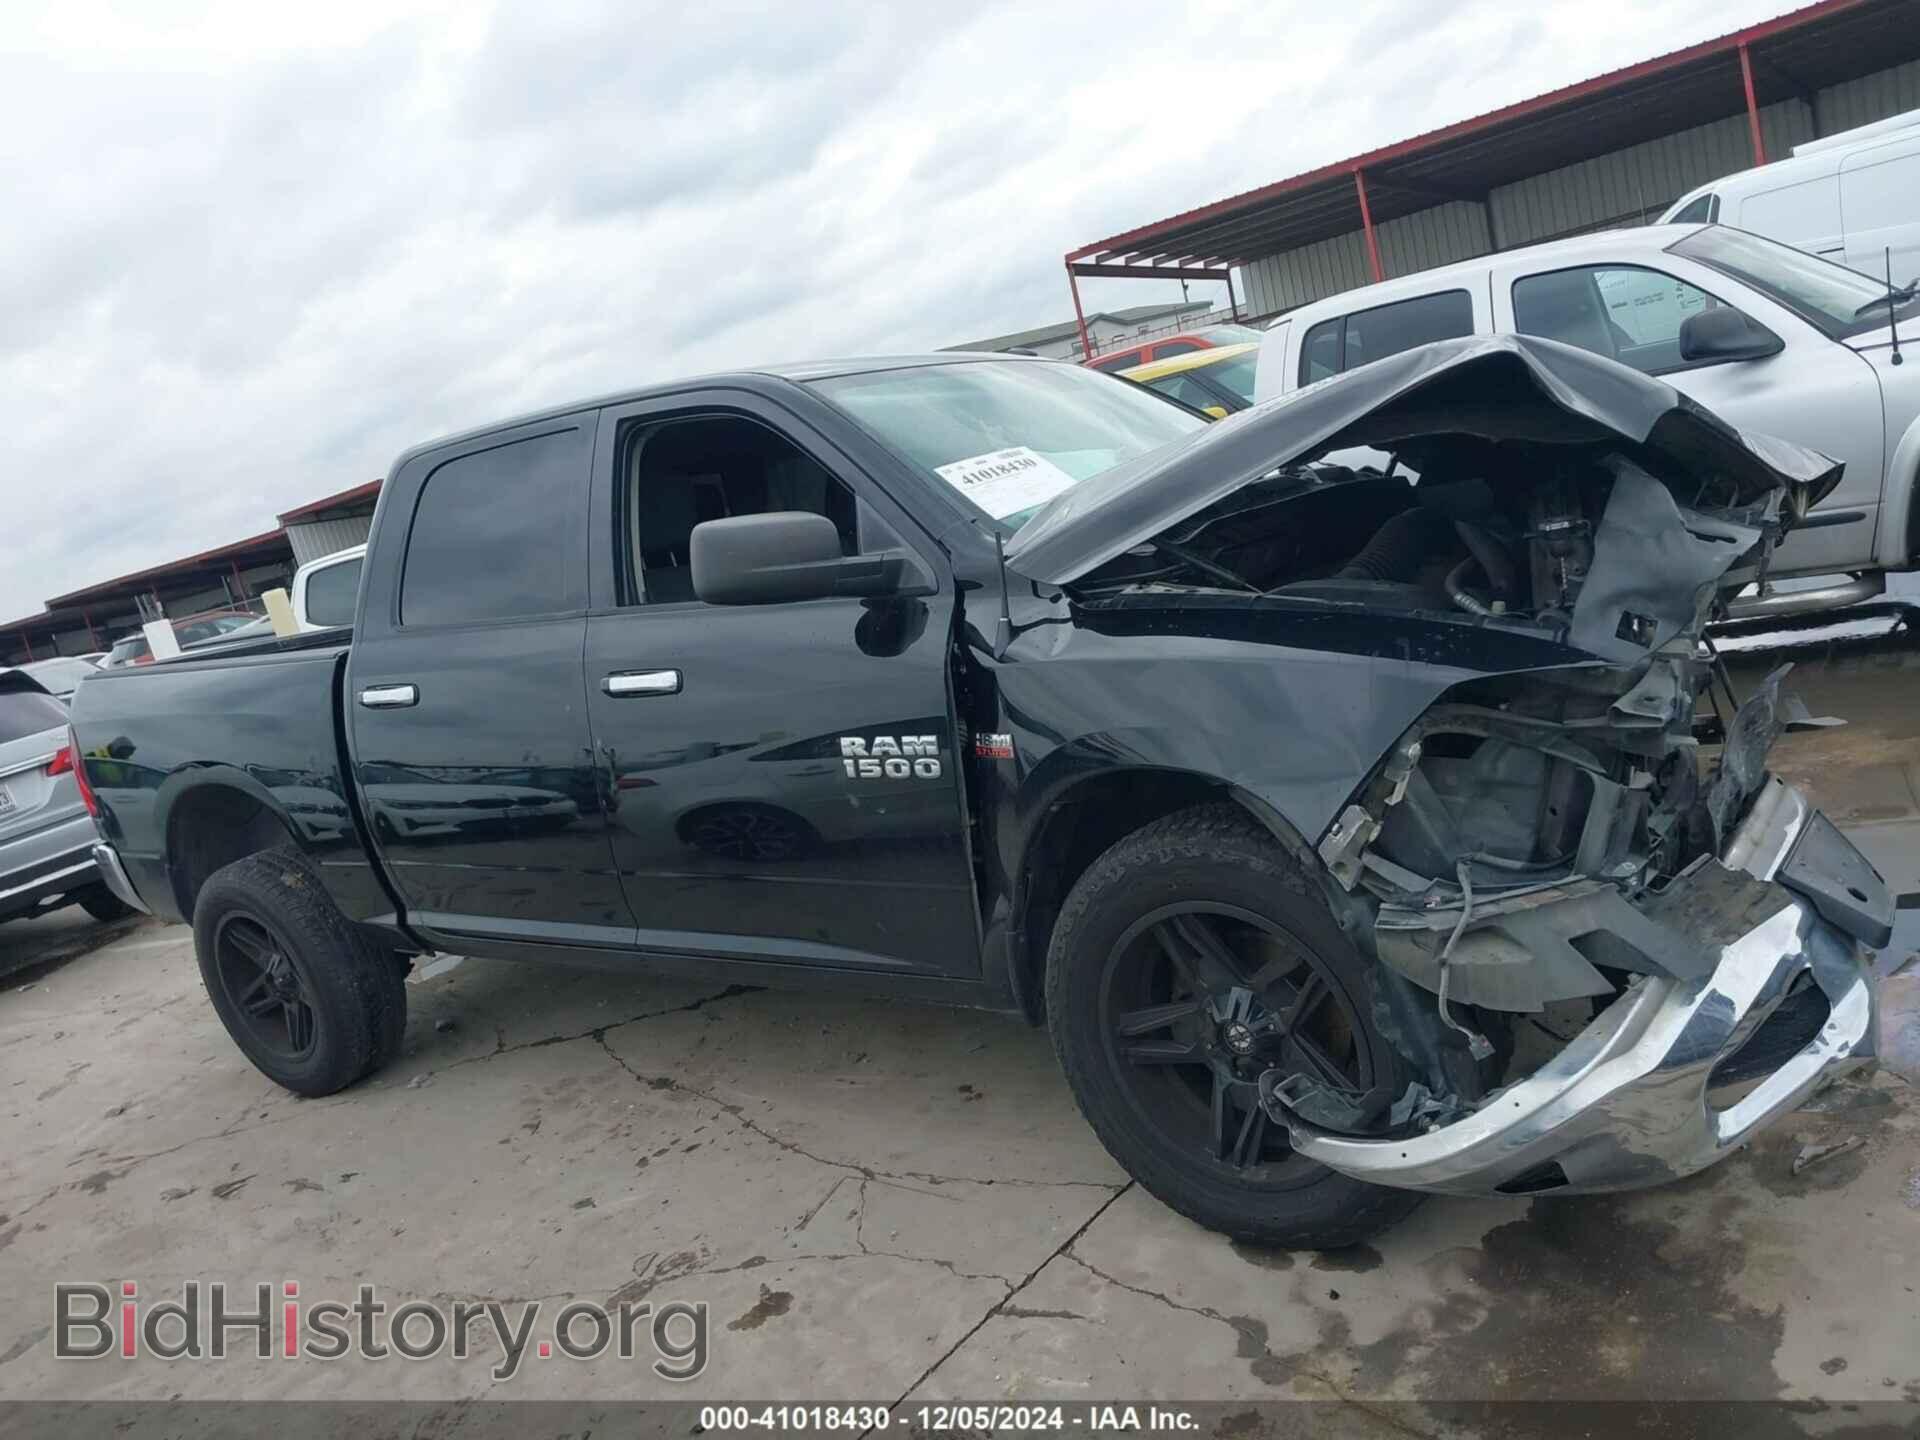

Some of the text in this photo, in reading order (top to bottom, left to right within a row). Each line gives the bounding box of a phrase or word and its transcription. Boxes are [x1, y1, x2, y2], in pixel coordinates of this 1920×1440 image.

[961, 457, 1038, 486] 41018430
[840, 735, 940, 757] RAM
[843, 758, 942, 779] 1500
